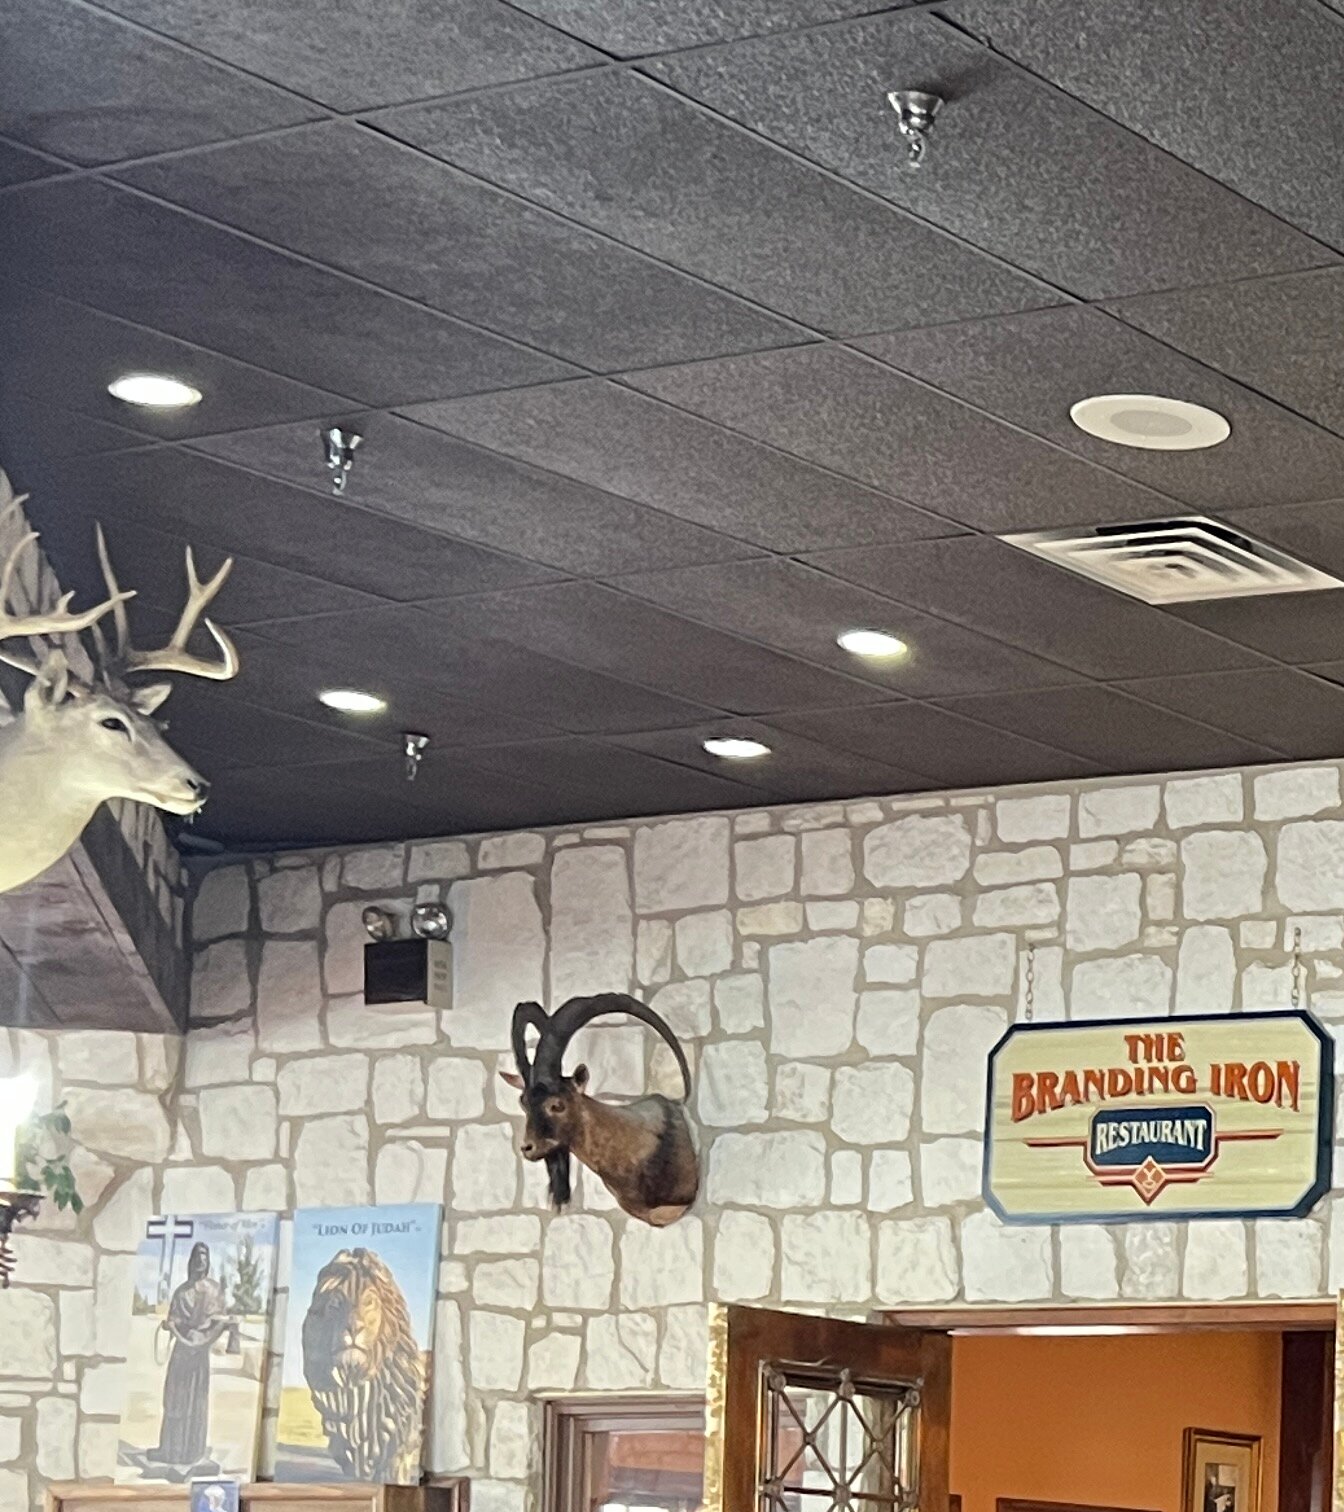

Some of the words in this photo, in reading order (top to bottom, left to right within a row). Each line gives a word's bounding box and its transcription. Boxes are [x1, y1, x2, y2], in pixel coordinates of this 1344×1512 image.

[1124, 1032, 1185, 1063] THE
[1010, 1065, 1198, 1123] BRANDING
[1209, 1060, 1300, 1113] IRON
[1096, 1118, 1208, 1155] RESTAURANT
